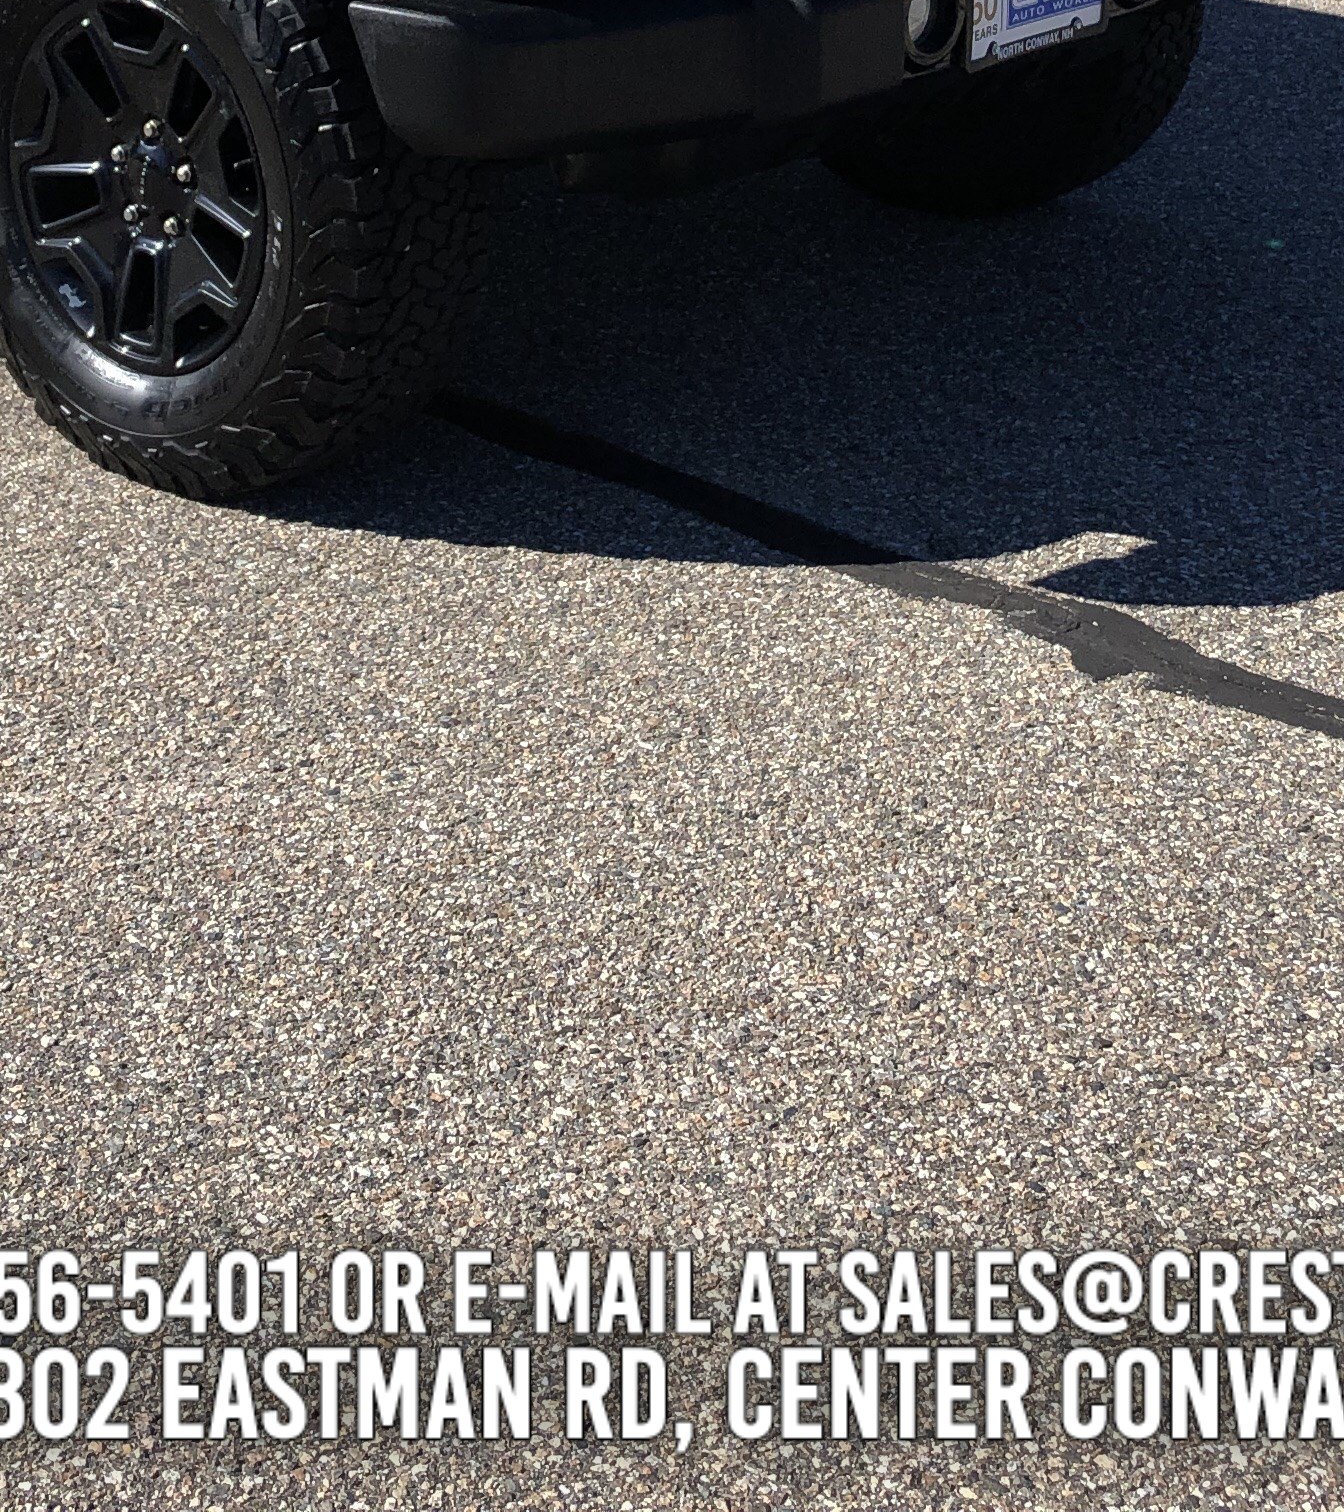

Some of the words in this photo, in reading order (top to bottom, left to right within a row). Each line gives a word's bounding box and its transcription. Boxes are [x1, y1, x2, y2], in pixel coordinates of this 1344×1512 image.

[1011, 5, 1045, 23] AUTO
[973, 23, 998, 42] EARS
[996, 41, 1024, 61] NORTH
[1061, 27, 1074, 41] NH
